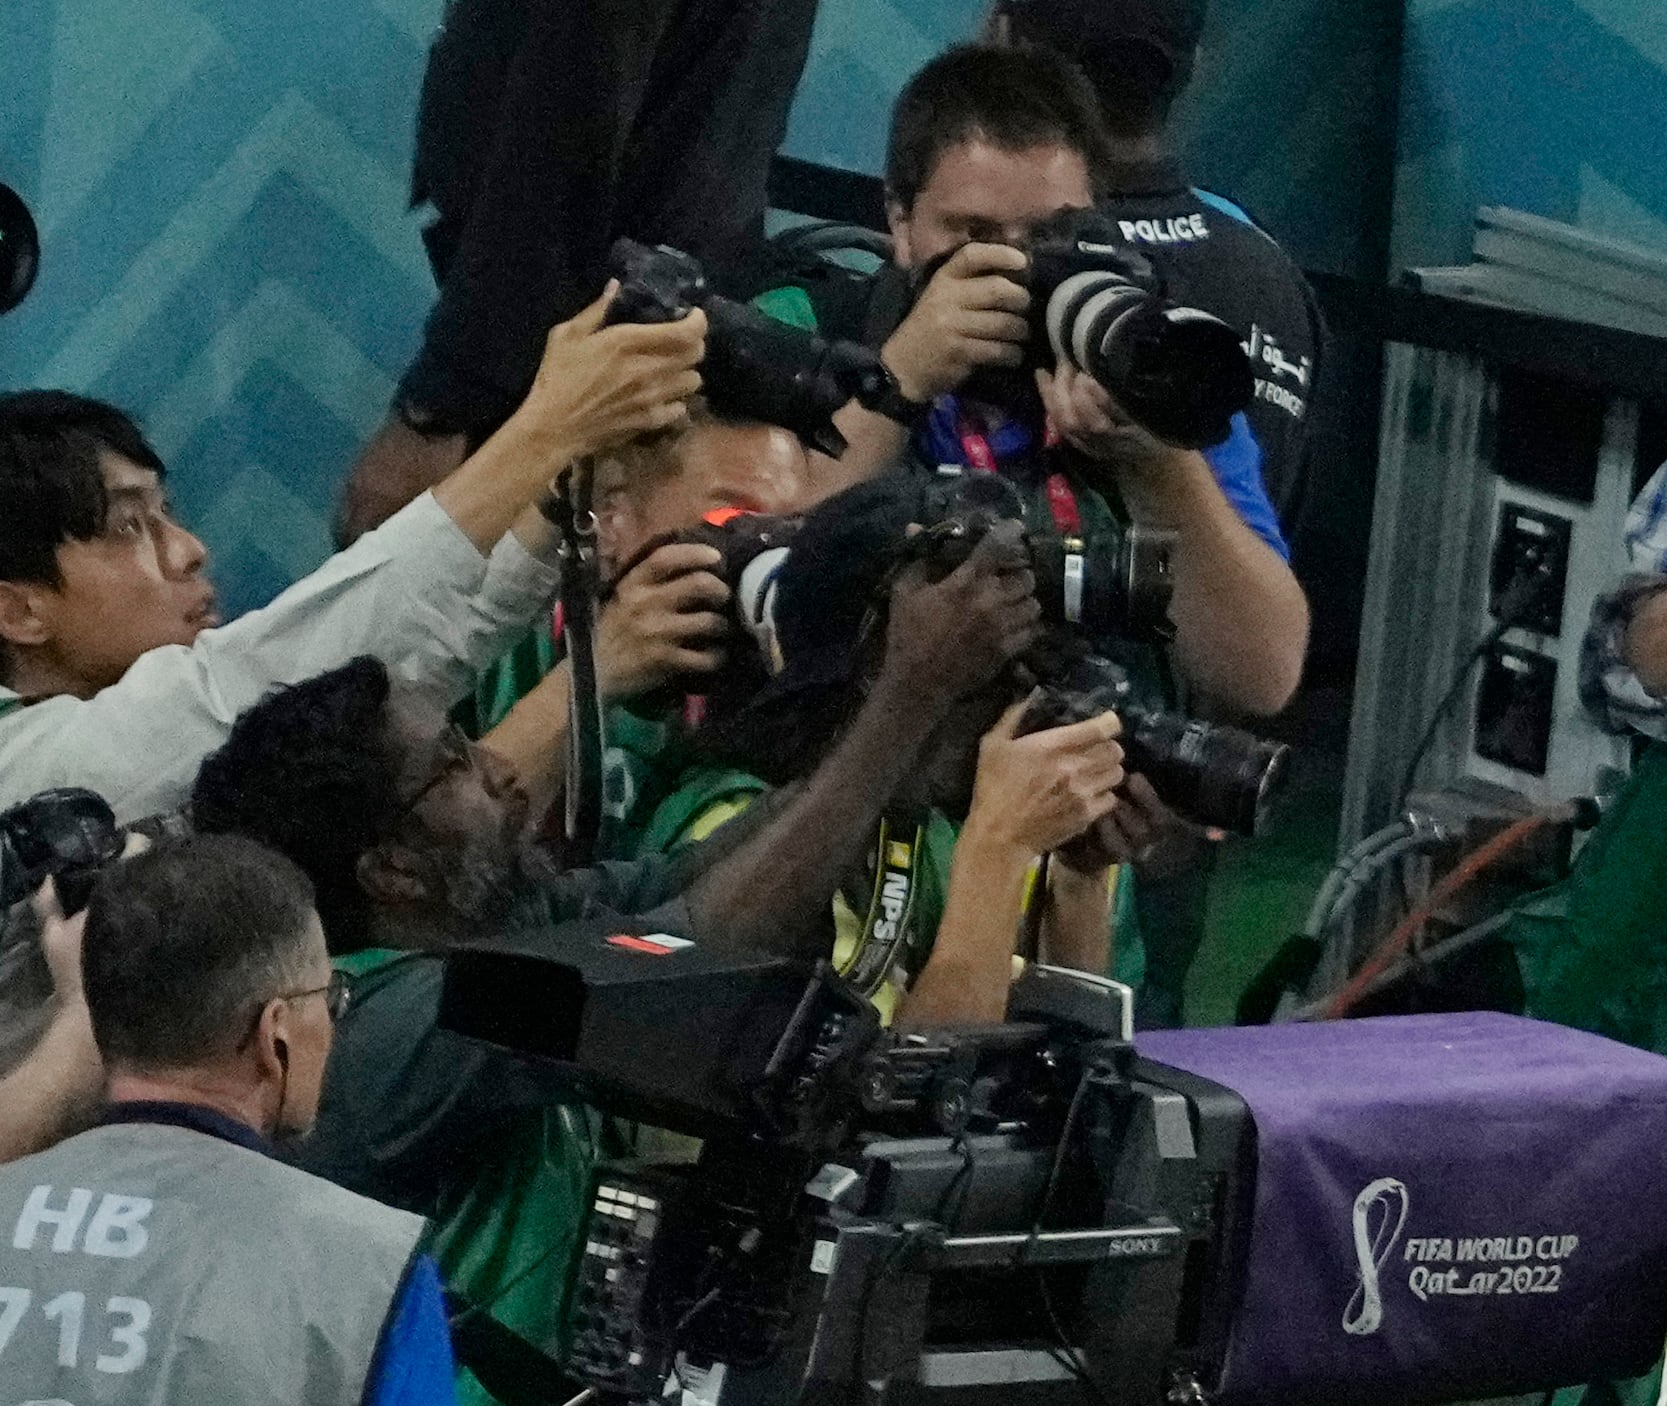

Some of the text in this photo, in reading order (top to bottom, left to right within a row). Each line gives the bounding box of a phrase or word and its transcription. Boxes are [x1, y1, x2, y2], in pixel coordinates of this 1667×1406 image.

[1117, 212, 1210, 242] POLICE
[873, 871, 909, 940] NPS
[13, 1184, 153, 1258] HB
[1108, 1239, 1161, 1256] SONY
[1403, 1234, 1580, 1261] FIFA WORLD CUP
[0, 1286, 151, 1373] 713
